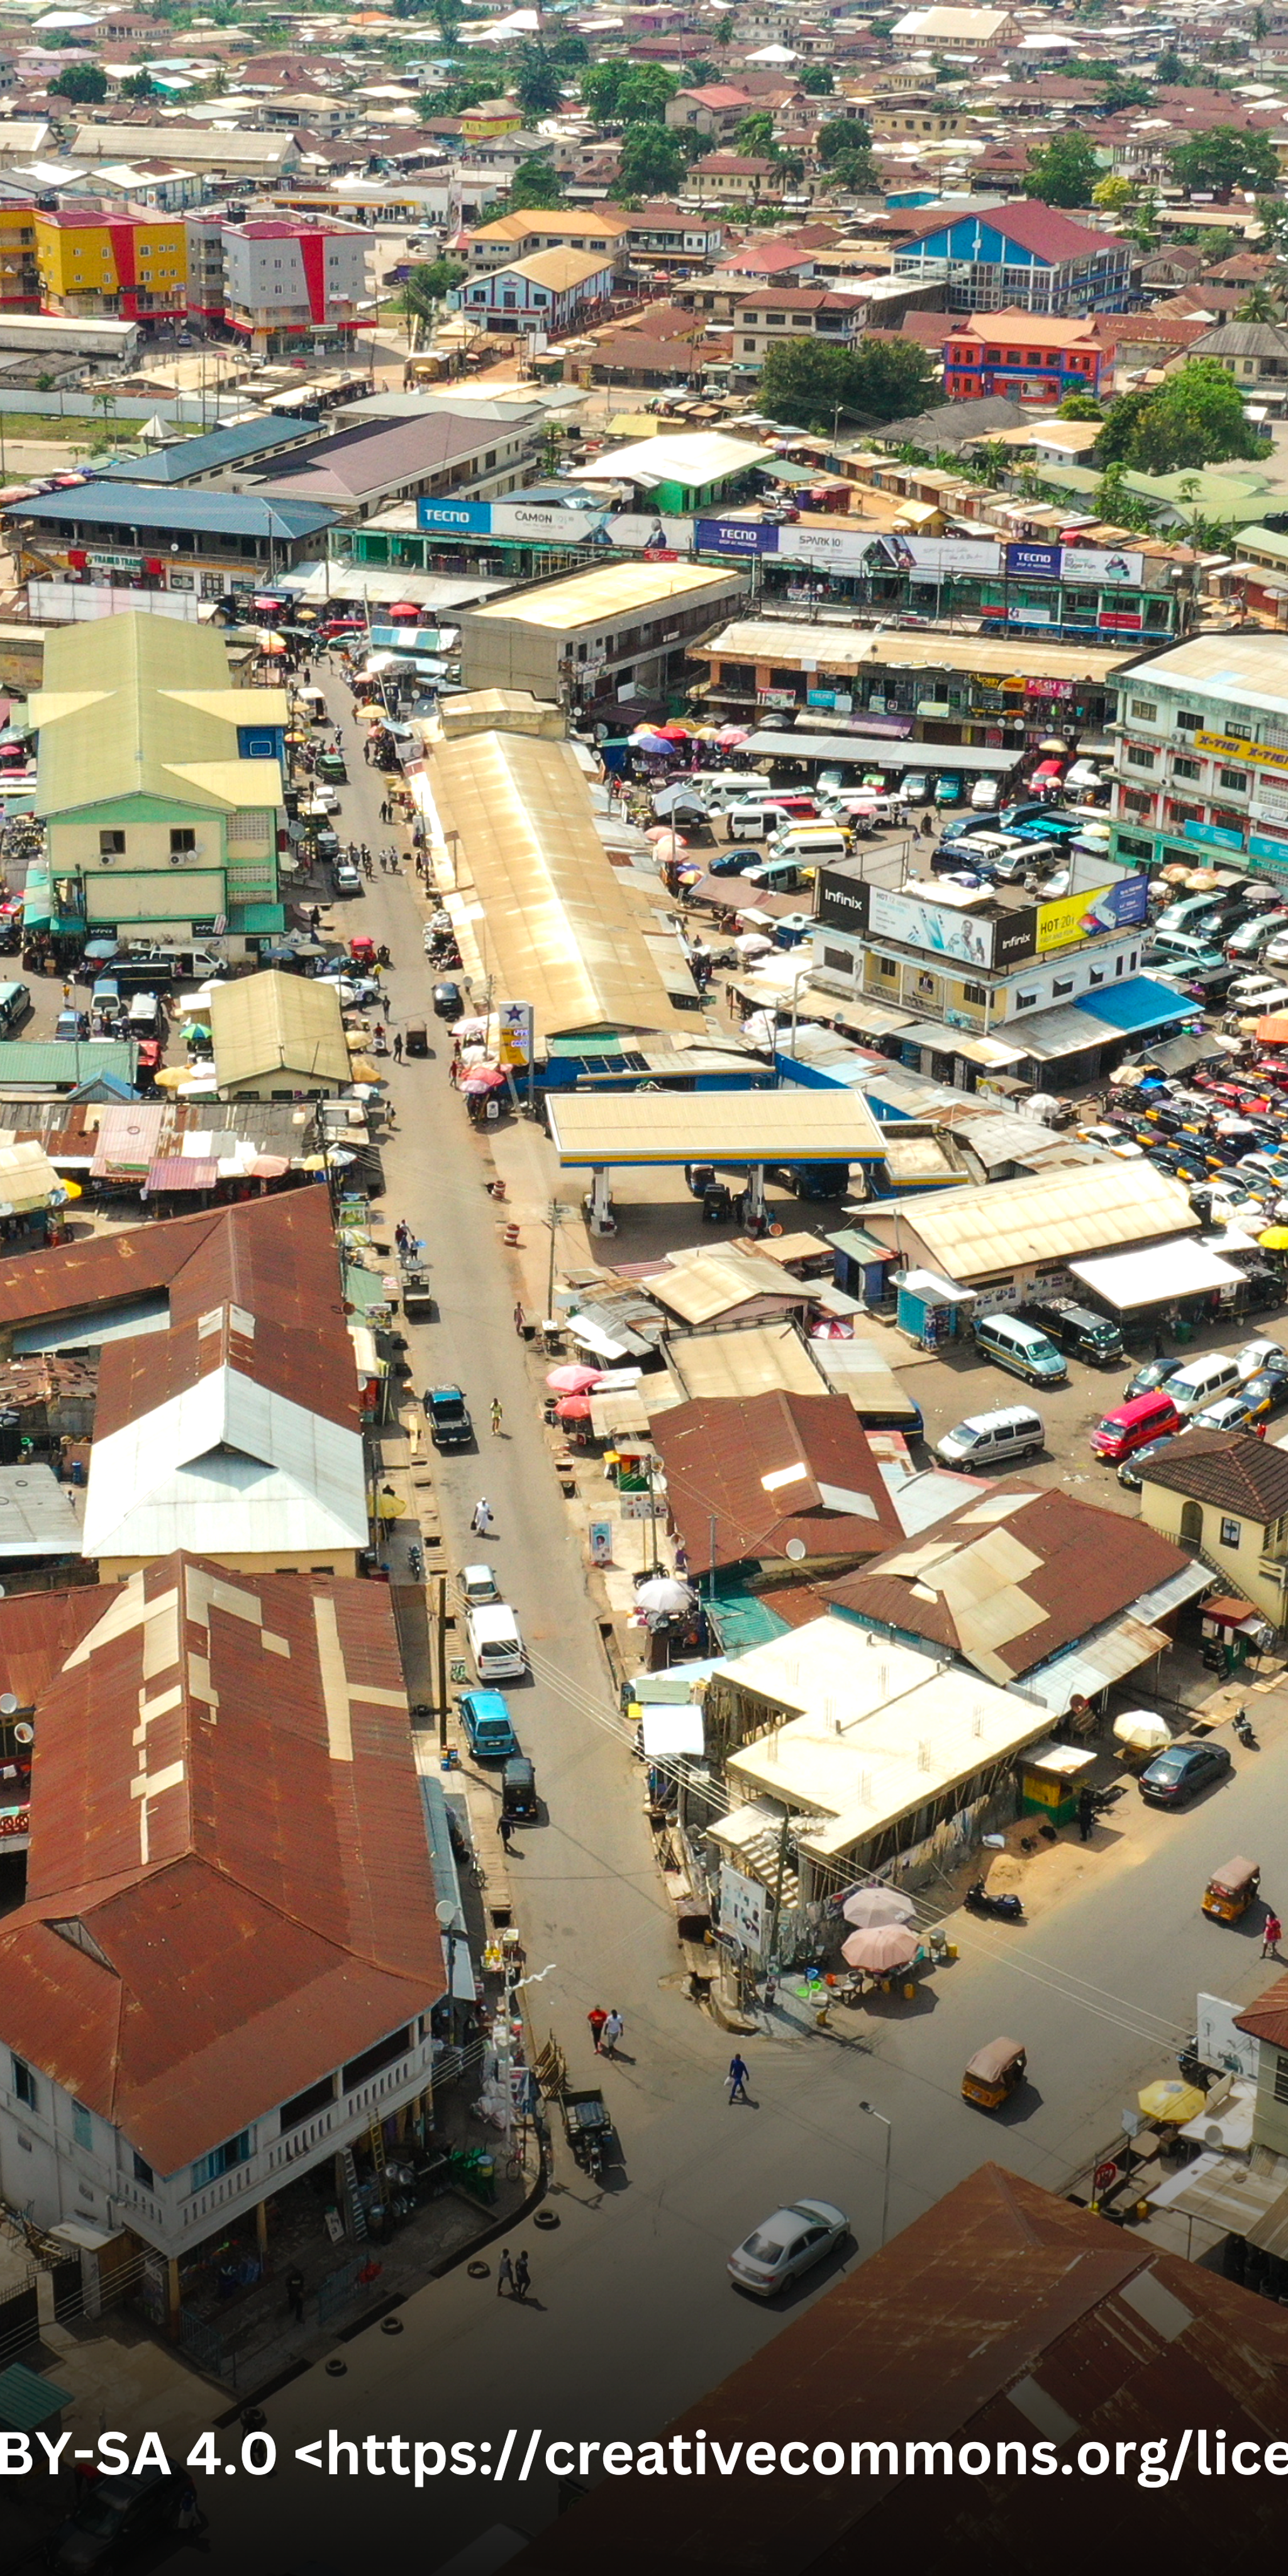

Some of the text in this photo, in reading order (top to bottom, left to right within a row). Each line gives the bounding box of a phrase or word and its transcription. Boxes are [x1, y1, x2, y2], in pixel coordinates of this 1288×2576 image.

[425, 509, 470, 523] TECNO
[514, 510, 552, 523] CAMON
[719, 528, 757, 541] TECNO
[799, 535, 830, 545] SPARK
[1017, 552, 1051, 564] TECNO
[824, 888, 862, 911] Infinix
[1040, 918, 1060, 935] HOT
[1002, 933, 1031, 950] Infinix
